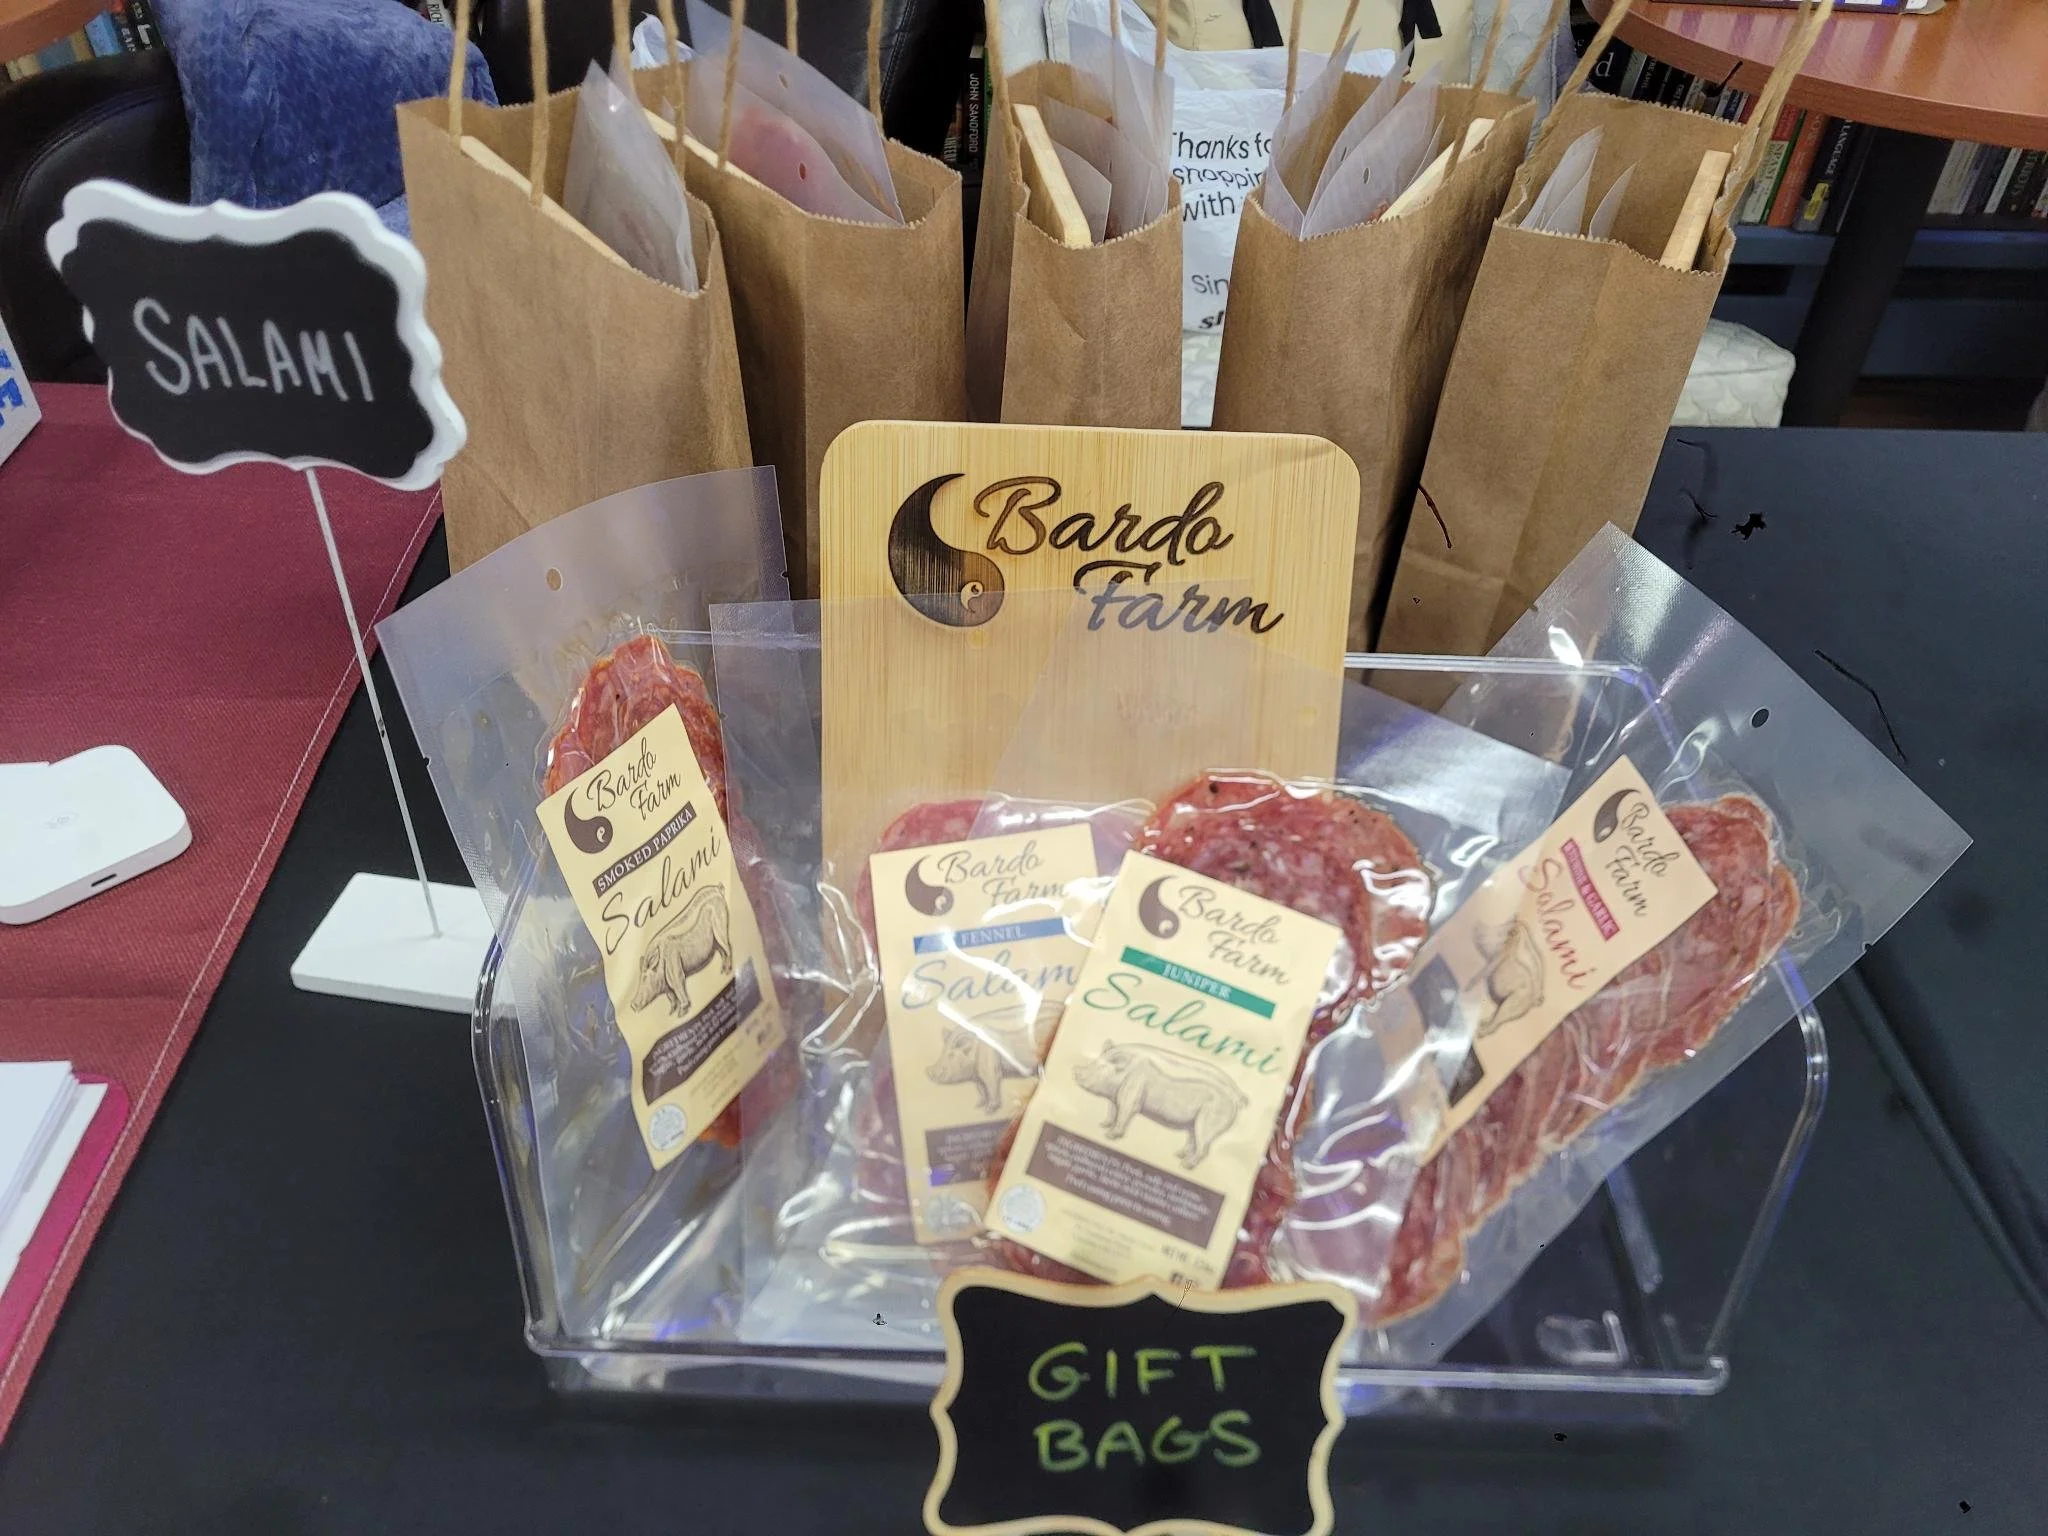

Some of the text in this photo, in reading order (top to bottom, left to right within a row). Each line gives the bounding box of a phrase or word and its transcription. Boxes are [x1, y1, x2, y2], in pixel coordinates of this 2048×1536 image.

[968, 73, 980, 153] JOHN SANDFORD
[1172, 131, 1250, 160] hanks
[133, 297, 375, 402] SALAMI
[973, 476, 1234, 565] Bardo
[1073, 560, 1285, 634] Farm
[586, 737, 657, 812] Bardo
[630, 772, 682, 820] Farm
[597, 808, 693, 892] SMOKED PAPRIKA
[938, 840, 1044, 884] Bardo
[1622, 802, 1681, 877] Bardo
[602, 825, 721, 955] Salami
[982, 876, 1066, 908] Farm
[1179, 885, 1282, 944] Bardo
[1605, 845, 1649, 917] Farm
[960, 925, 1026, 946] FENNEL
[1208, 930, 1289, 985] Farm
[1517, 857, 1598, 990] Salami
[1161, 963, 1233, 1001] JUNIPER
[1083, 973, 1282, 1075] Salami
[1028, 1341, 1257, 1401] GIFT
[1033, 1409, 1262, 1472] BAGS
